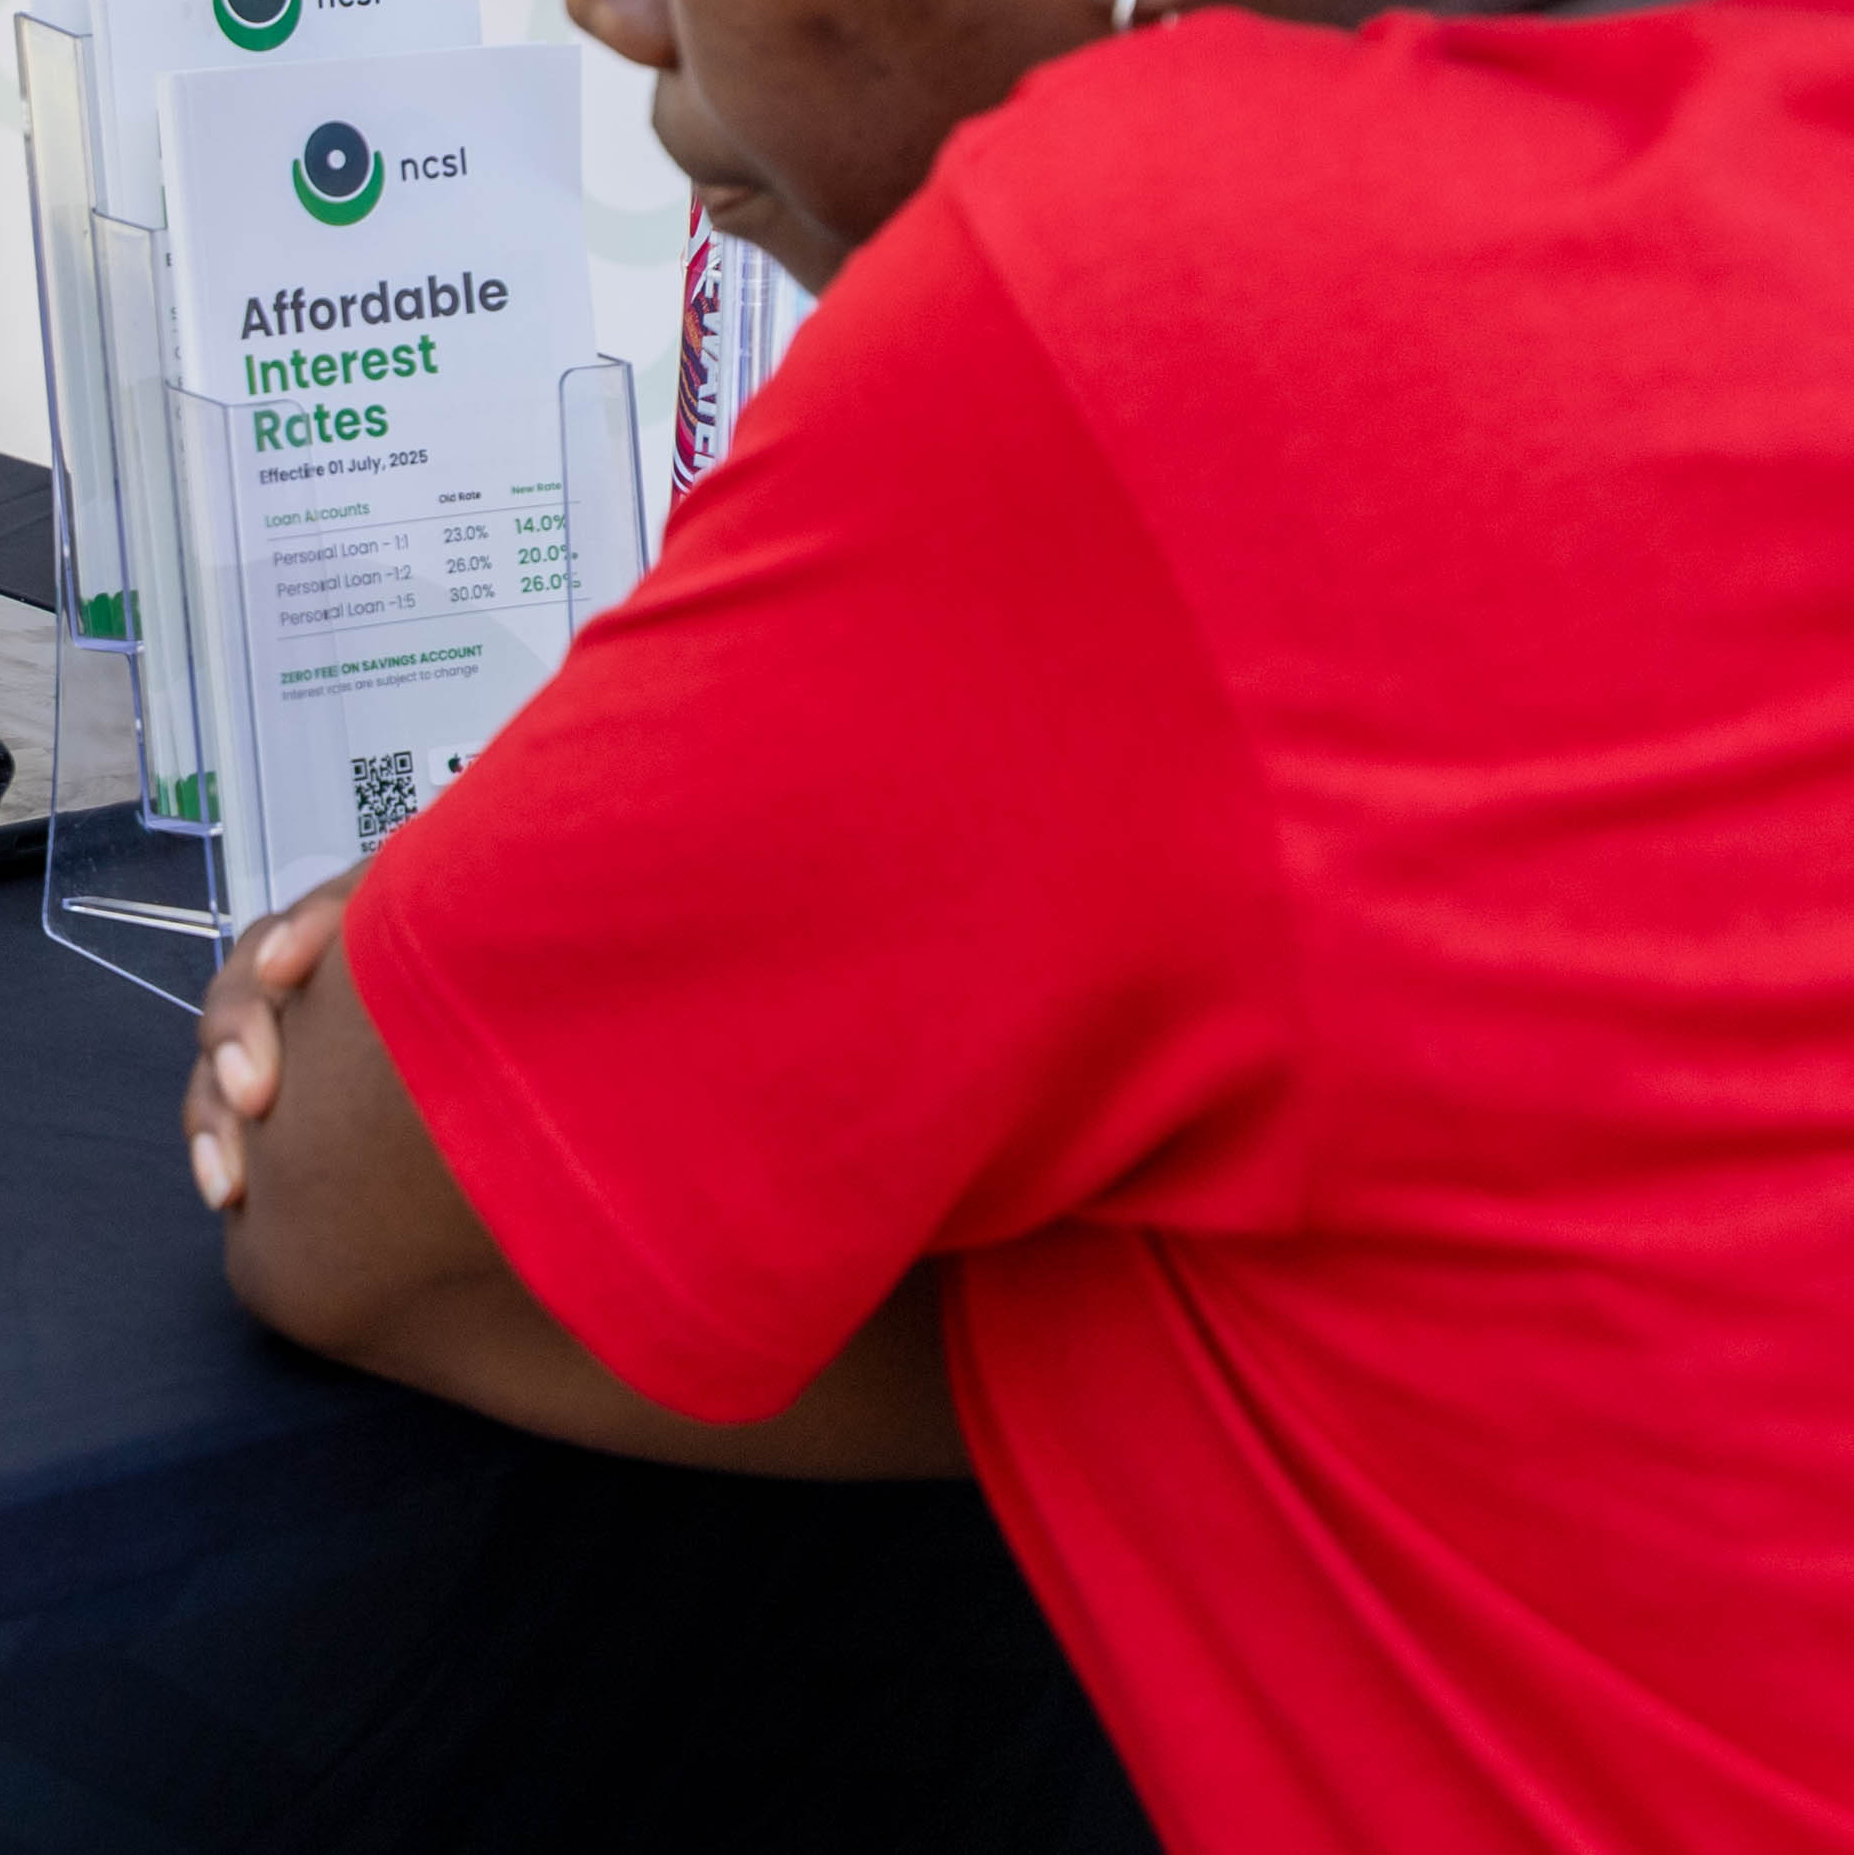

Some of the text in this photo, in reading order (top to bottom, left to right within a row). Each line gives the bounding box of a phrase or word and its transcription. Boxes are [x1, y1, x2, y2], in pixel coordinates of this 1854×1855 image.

[399, 147, 469, 182] ncsl
[241, 271, 509, 340] Affordable
[244, 334, 439, 396] Interest
[252, 397, 389, 453] Rates
[328, 460, 344, 475] 01
[347, 454, 386, 474] July,
[389, 449, 428, 467] 2025
[438, 490, 482, 504] Old Rate
[511, 481, 562, 495] New Rate
[265, 512, 301, 528] Loan
[513, 514, 567, 535] 14.0%
[442, 525, 489, 544] 23.0%
[341, 539, 379, 556] Loan
[517, 544, 579, 566] 20.0%
[446, 555, 493, 574] 26.0%
[344, 569, 382, 588] Loan
[520, 572, 581, 595] 26.0%
[450, 583, 495, 603] 30.0%
[347, 597, 385, 616] Loan
[281, 671, 312, 685] ZERO
[341, 663, 360, 675] ON
[362, 654, 416, 671] SAVINGS
[420, 645, 483, 664] ACCOUNT
[283, 686, 324, 701] Interest
[355, 679, 373, 690] are
[376, 671, 417, 691] subject
[420, 669, 431, 680] to
[434, 663, 479, 680] change
